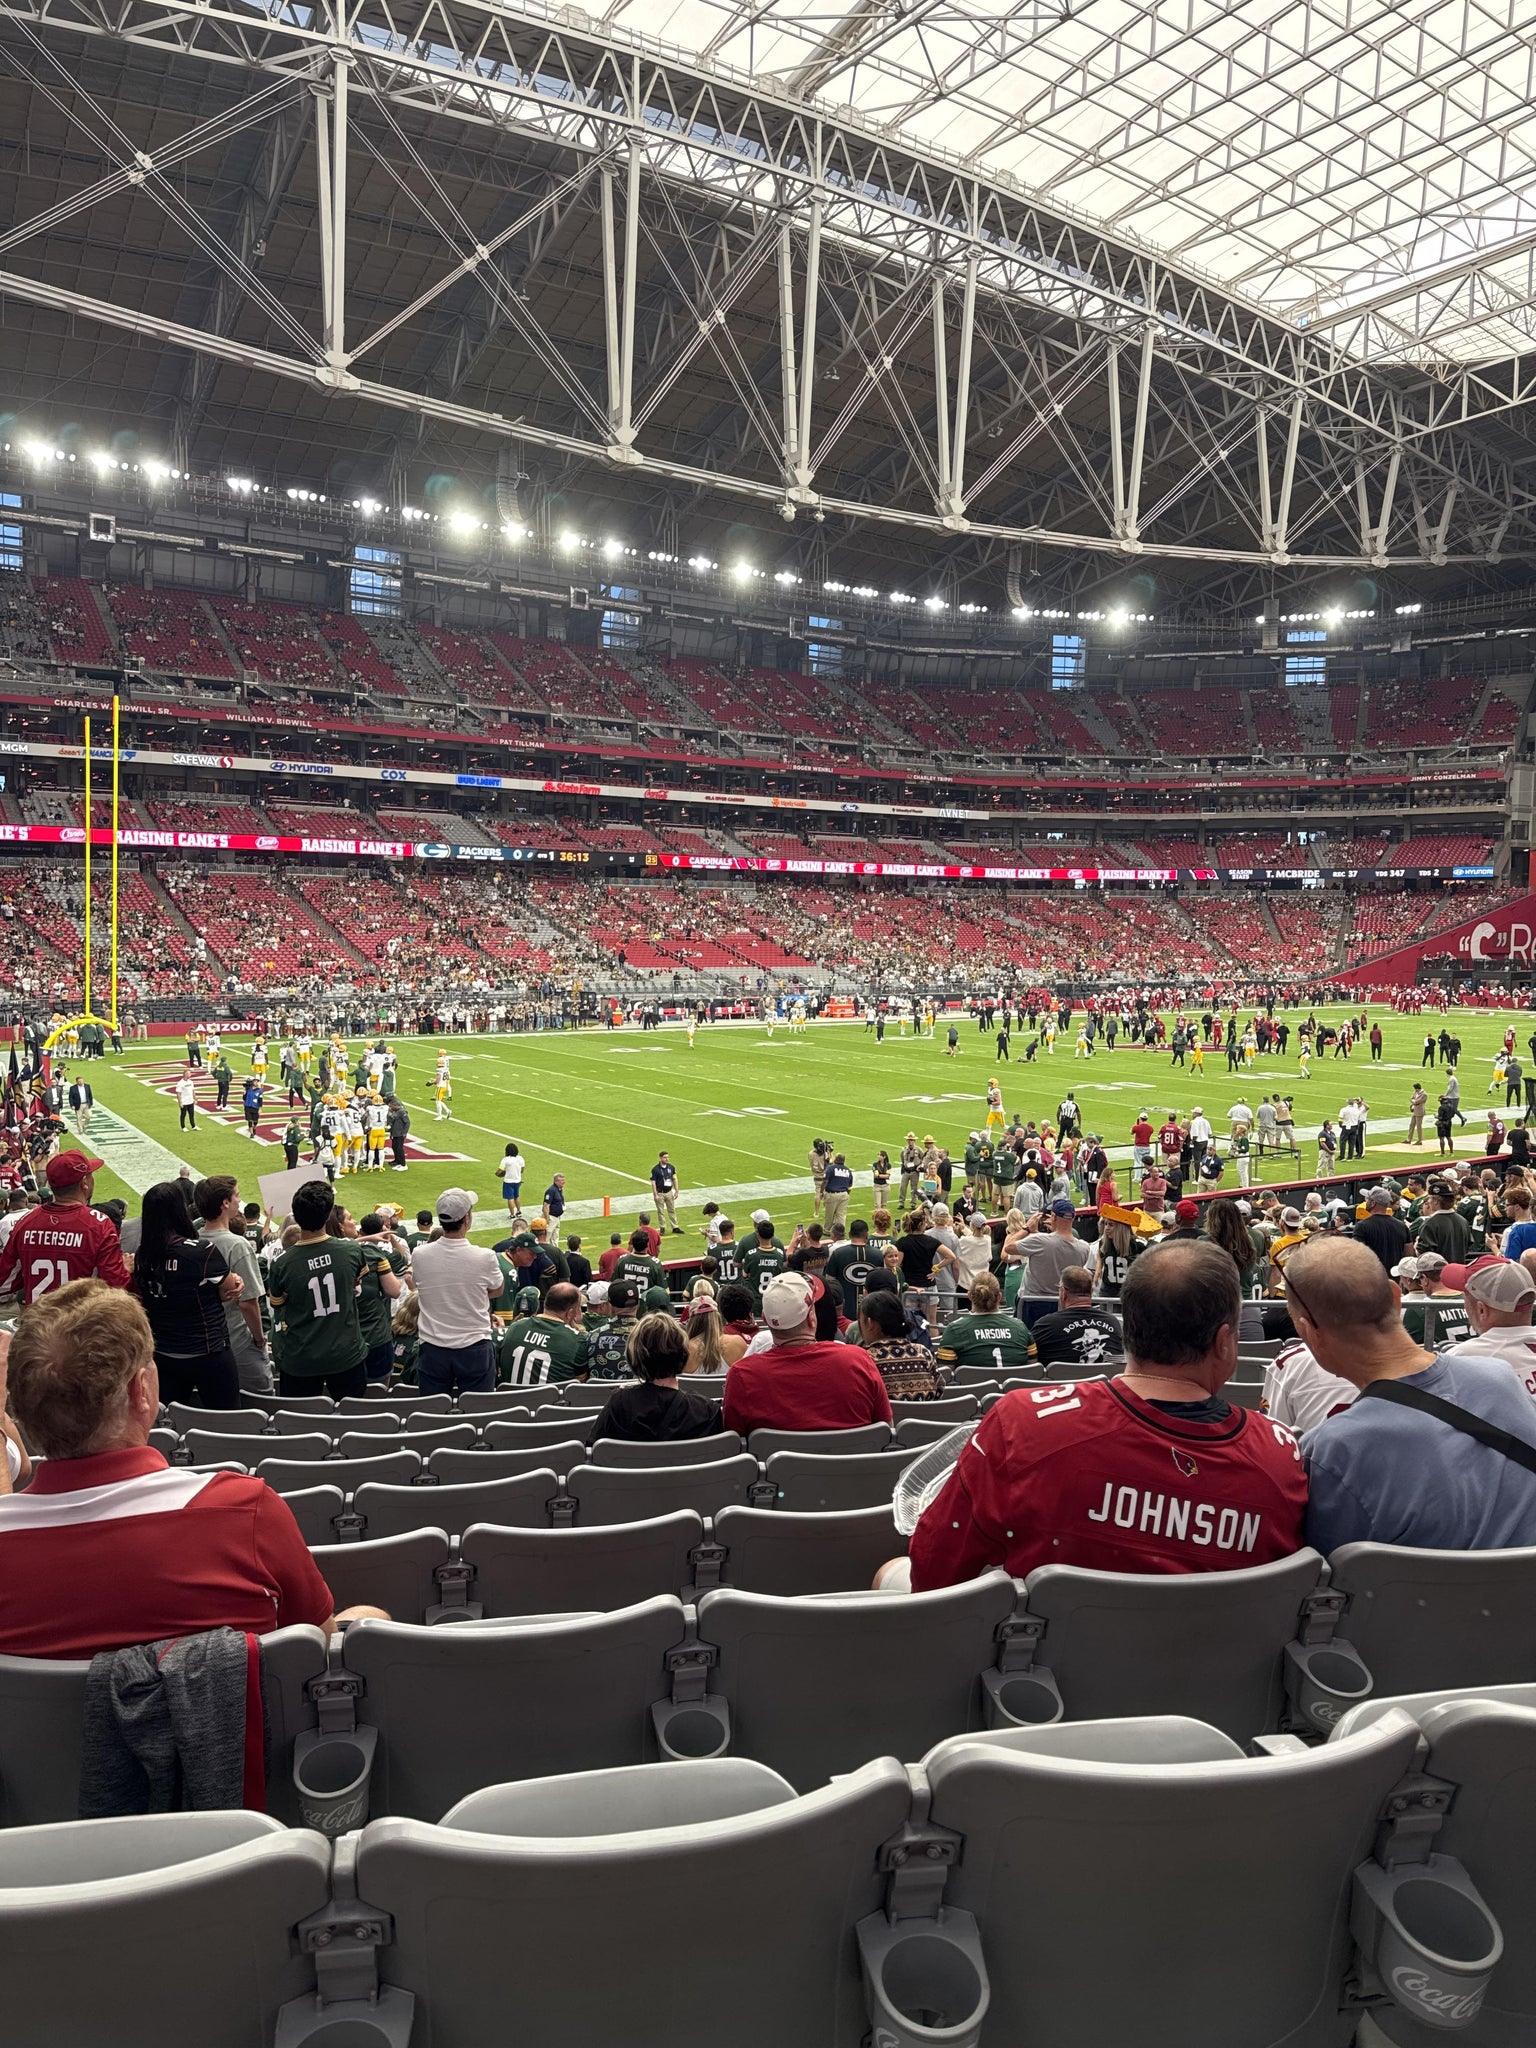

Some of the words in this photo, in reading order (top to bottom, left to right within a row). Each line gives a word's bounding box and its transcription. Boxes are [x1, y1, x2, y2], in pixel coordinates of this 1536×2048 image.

[54, 699, 98, 709] CHARLES
[101, 701, 113, 710] W.
[226, 714, 264, 723] WILLIAM
[277, 718, 312, 727] BIDWILL
[1, 743, 28, 752] MGM
[514, 740, 545, 748] TILLMAN
[173, 754, 218, 767] SAFEWAY
[288, 765, 333, 774] HYUNDAI
[381, 769, 407, 781] COX
[457, 776, 475, 785] BUD
[476, 778, 500, 787] LIGHT
[116, 830, 174, 845] RAISING
[178, 833, 229, 848] CANE'S
[302, 839, 356, 853] RAISING
[360, 841, 404, 855] CANE'S
[459, 846, 501, 857] PACKERS
[513, 849, 522, 860] 0
[560, 852, 589, 862] 36:13
[673, 855, 680, 866] 0
[689, 856, 733, 866] CARDINALS
[786, 861, 823, 872] RAISING
[882, 864, 916, 875] RAISING
[1098, 869, 1135, 880] RAISING
[1138, 869, 1170, 880] CANE'S
[1266, 870, 1275, 878] T.
[1276, 870, 1321, 878] MCBRIDE
[1348, 870, 1358, 878] 37
[1389, 869, 1405, 877] 347
[325, 1116, 337, 1127] 91
[1164, 1132, 1175, 1145] 81
[23, 1230, 84, 1248] PETERSON
[307, 1253, 333, 1271] REED
[624, 1262, 651, 1275] MATTHEWS
[758, 1259, 778, 1268] JACOBS
[718, 1260, 739, 1281] 10
[1105, 1256, 1129, 1284] 12
[31, 1259, 70, 1306] 21
[759, 1272, 774, 1295] 8
[308, 1272, 340, 1318] 11
[1063, 1318, 1115, 1334] BORRACHO
[524, 1330, 550, 1348] LOVE
[974, 1328, 1012, 1340] PARSONS
[992, 1347, 1003, 1368] 1
[510, 1346, 552, 1385] 10
[1087, 1481, 1262, 1553] JOHNSON
